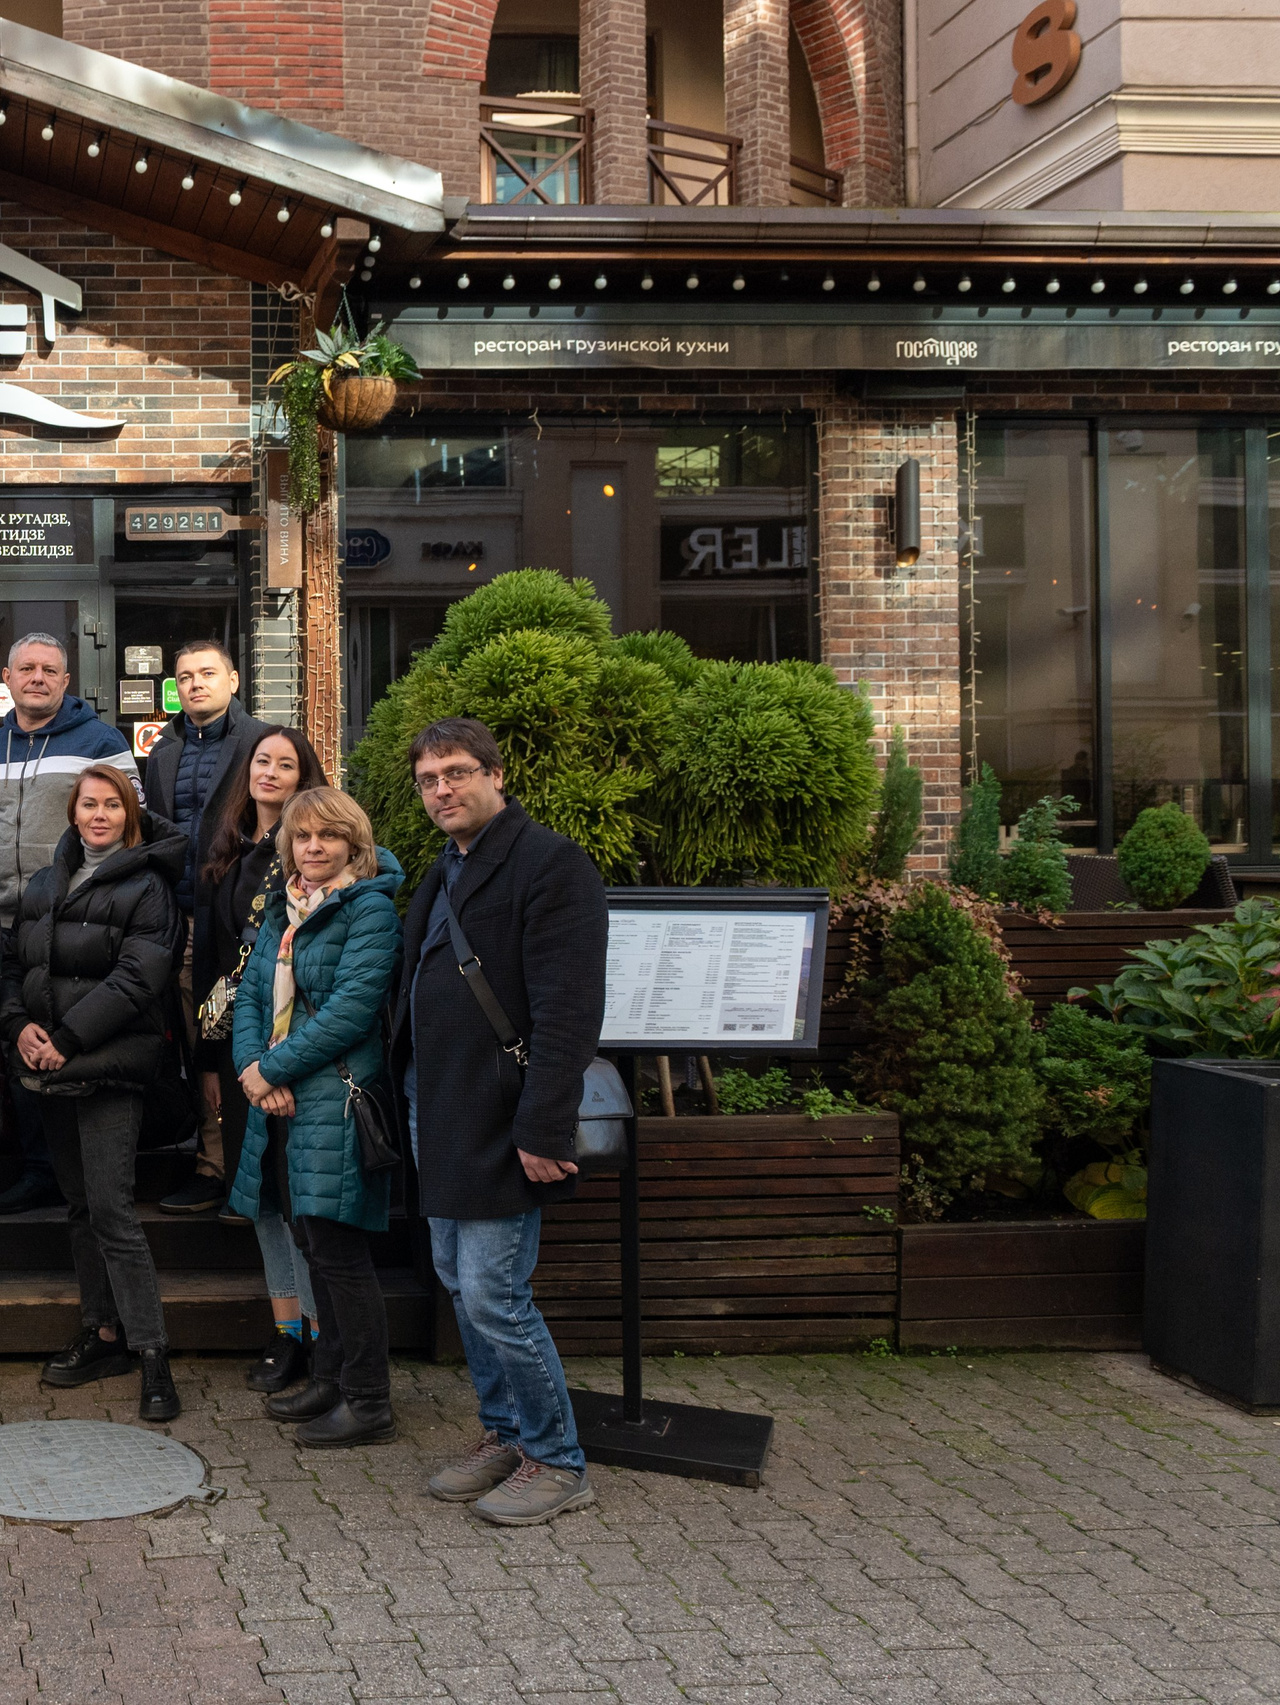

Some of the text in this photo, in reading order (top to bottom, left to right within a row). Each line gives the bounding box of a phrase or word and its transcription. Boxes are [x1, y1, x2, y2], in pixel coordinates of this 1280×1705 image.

[474, 337, 729, 356] ресторан грузинской кухни
[1167, 340, 1280, 356] ресторан гру
[8, 513, 71, 527] РУГАДЗЕ,
[280, 530, 289, 566] ВИНА
